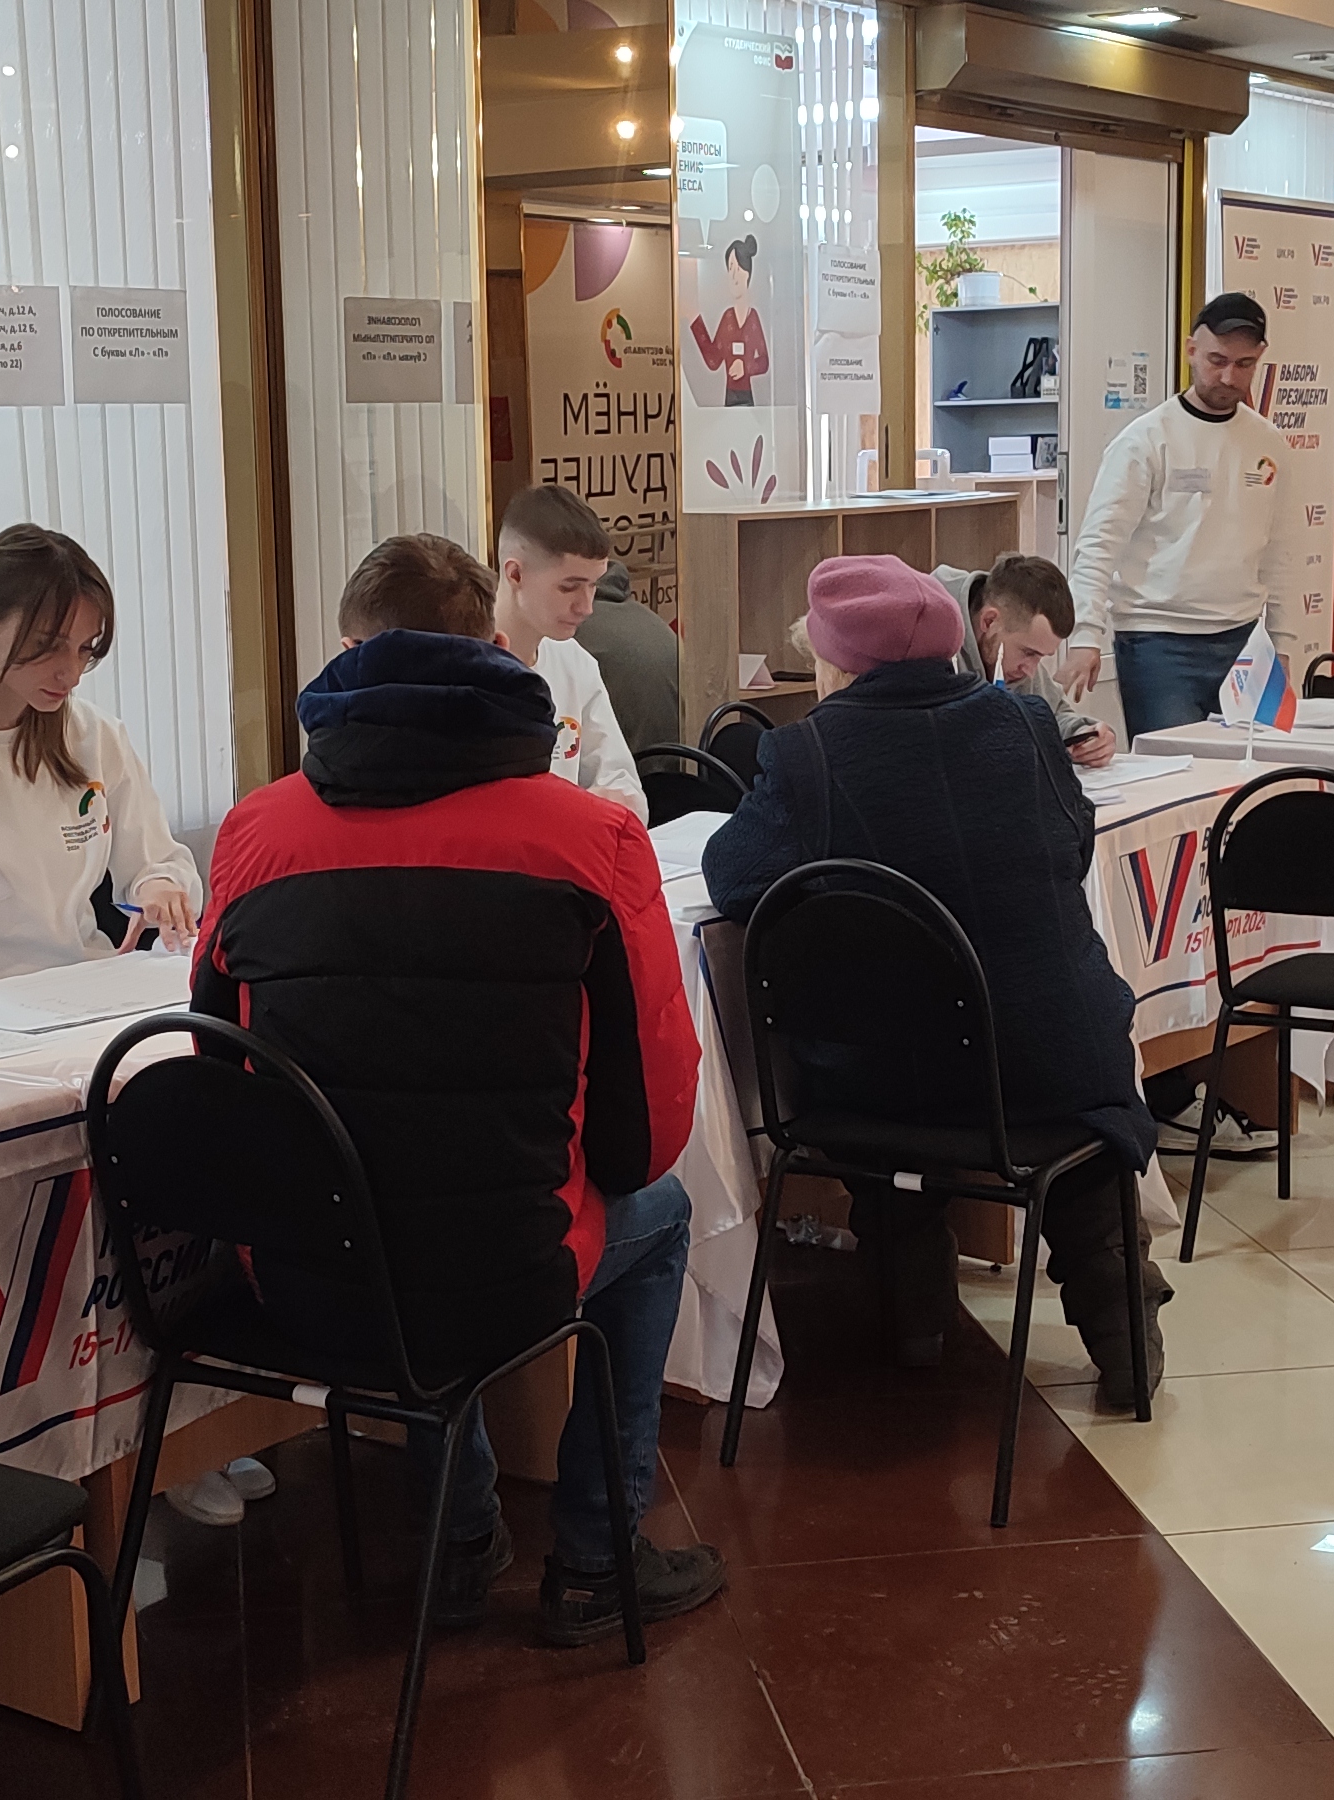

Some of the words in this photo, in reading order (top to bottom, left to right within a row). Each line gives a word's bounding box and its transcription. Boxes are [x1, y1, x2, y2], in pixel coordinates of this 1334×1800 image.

[725, 37, 771, 53] СТУДЕНЧЕСКИЙ
[754, 55, 771, 66] ОФИС
[681, 141, 721, 157] ВОПРОСЫ
[831, 260, 867, 271] ГОЛОСОВАНИЕ
[822, 273, 829, 281] ПО
[830, 274, 875, 286] ОТКРЕПИТЕЛЬНЫМ
[9, 305, 26, 316] д.12
[28, 306, 36, 316] А,
[97, 307, 161, 319] ГОЛОСОВАНИЕ
[10, 324, 27, 334] д.12
[29, 324, 37, 334] Б,
[81, 327, 94, 337] ПО
[97, 327, 178, 338] ОТКРЕПИТЕЛЬНЫМ
[9, 341, 22, 352] д.6
[93, 347, 99, 357] С
[101, 346, 126, 359] буквы
[10, 359, 22, 370] 22)
[1280, 364, 1319, 381] ВЫБОРЫ
[1276, 388, 1328, 408] ПРЕЗИДЕНТА
[1273, 412, 1306, 429] РОССИИ
